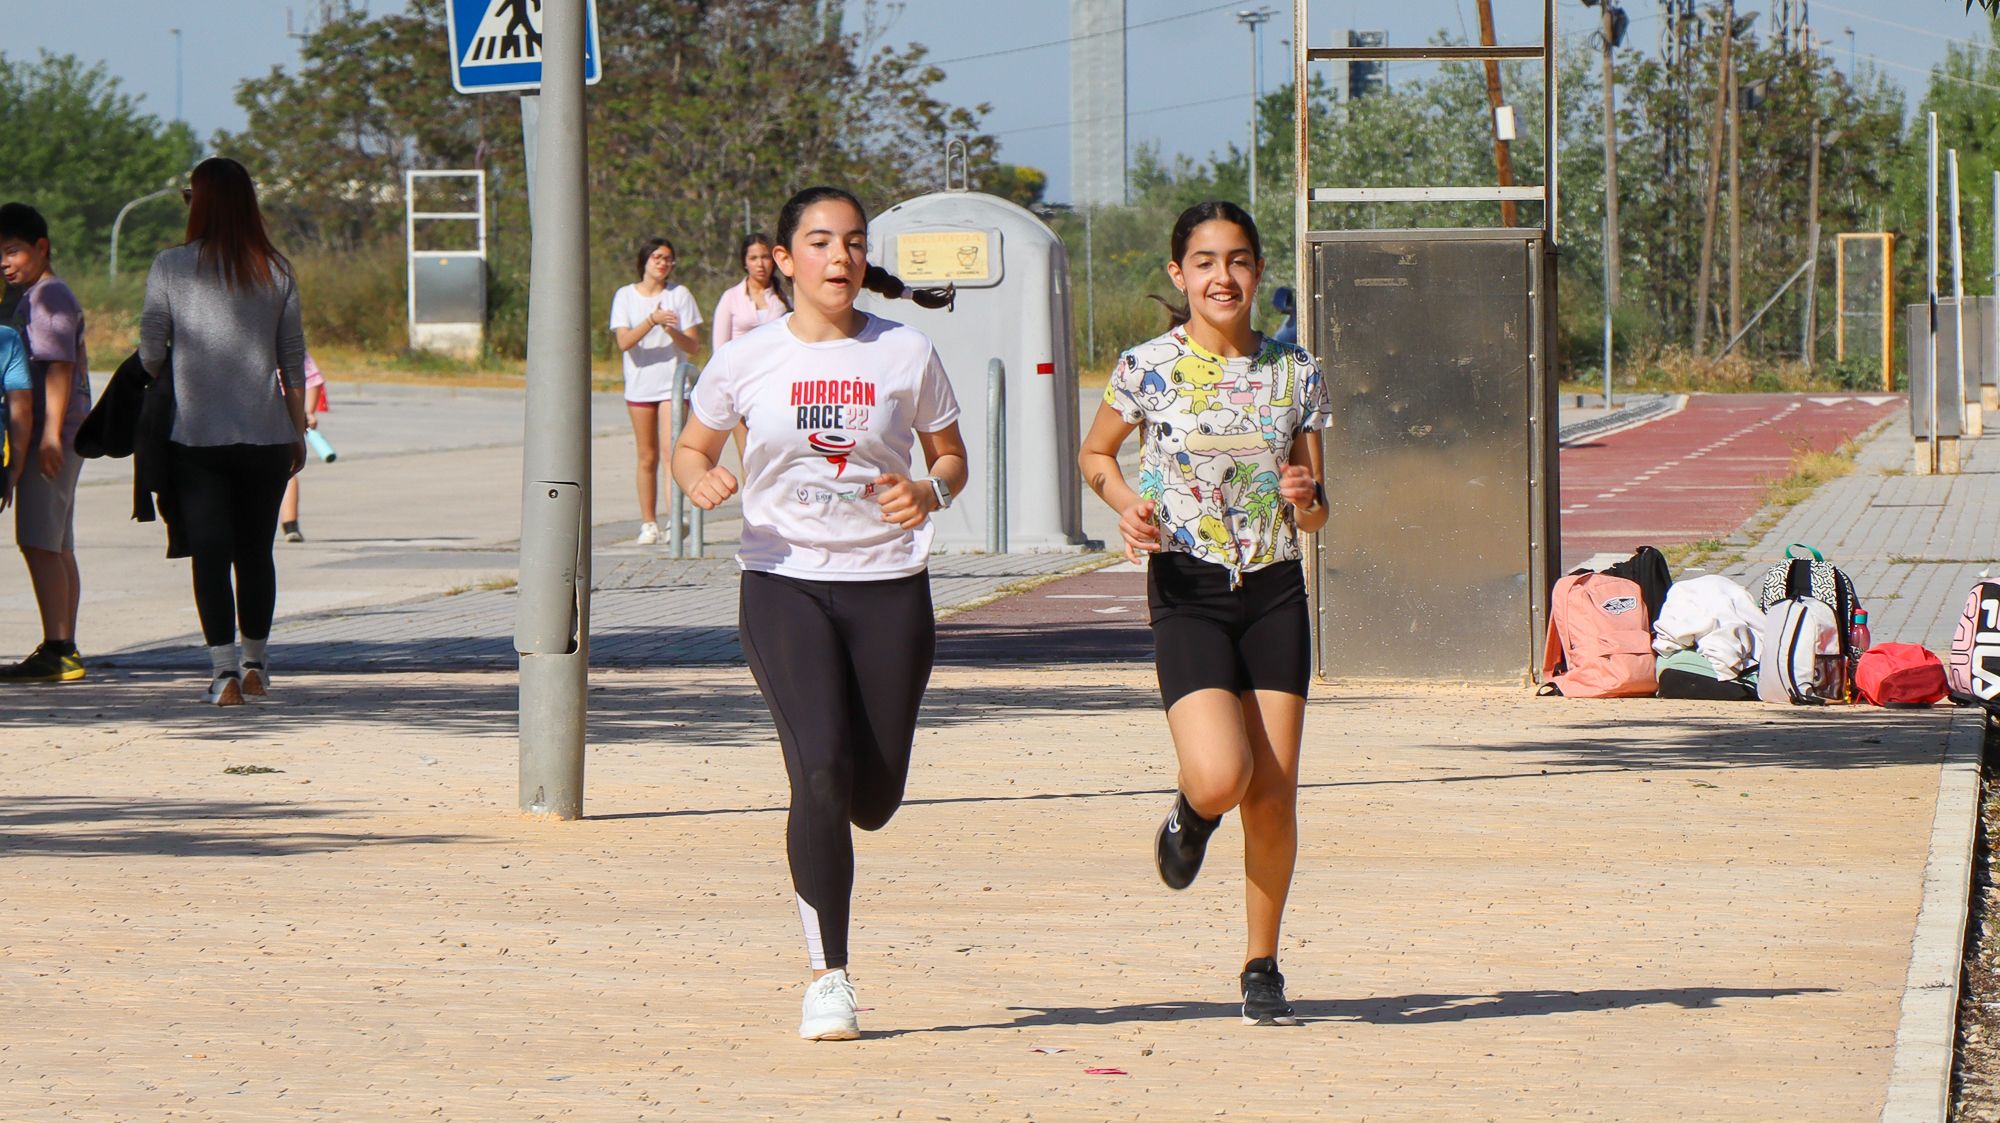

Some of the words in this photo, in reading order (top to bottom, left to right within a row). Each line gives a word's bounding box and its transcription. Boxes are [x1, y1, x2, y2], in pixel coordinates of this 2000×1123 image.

[790, 377, 876, 406] HURACÁN
[797, 405, 844, 430] RACE
[846, 407, 869, 431] 22
